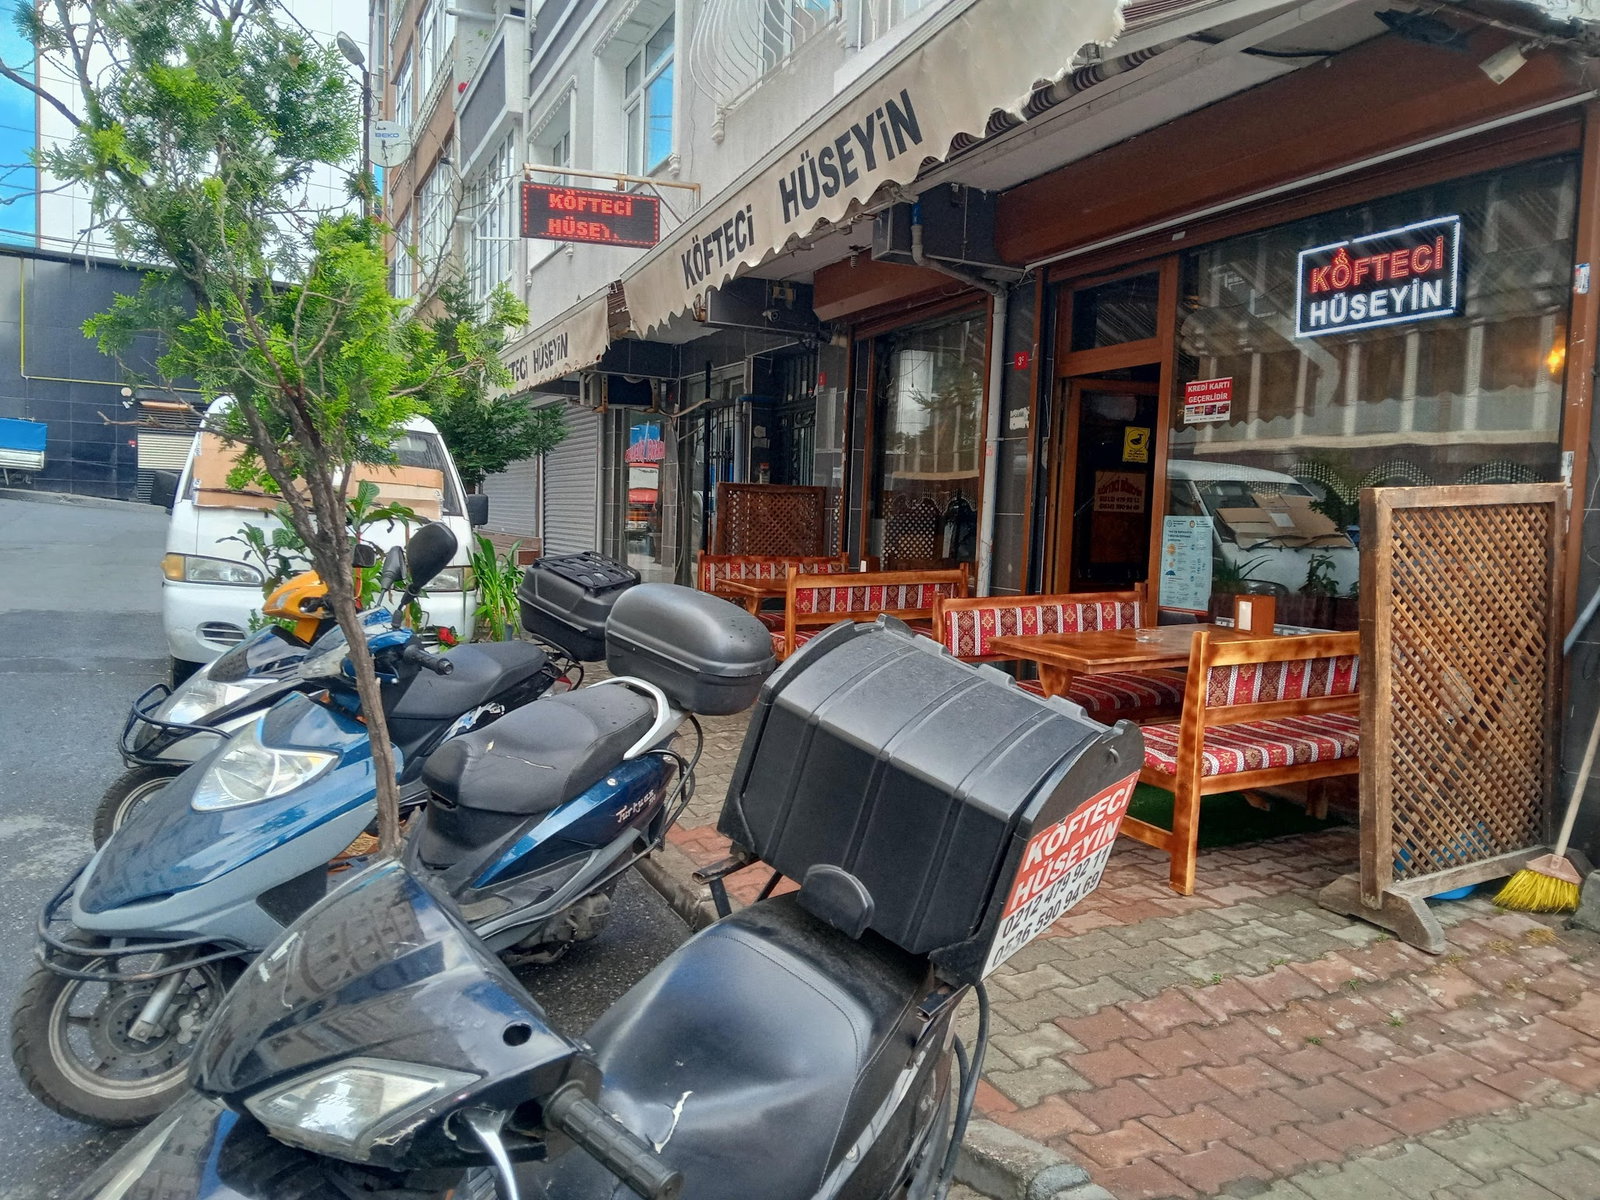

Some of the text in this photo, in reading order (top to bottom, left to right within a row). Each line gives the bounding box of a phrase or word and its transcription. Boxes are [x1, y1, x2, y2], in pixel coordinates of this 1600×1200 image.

[548, 189, 633, 216] KÖFTECİ
[681, 88, 923, 290] KÖFTECİ HÜSEYİN
[1310, 235, 1445, 293] KÖFTECİ
[1310, 278, 1444, 327] HÜSEYİN
[532, 332, 569, 374] HÜSEYİN
[1188, 381, 1230, 393] KREDİ KARTI
[1188, 392, 1228, 404] GEÇERLİDİR
[1023, 777, 1135, 872] KÖFTECİ
[1003, 845, 1109, 938] 0212 479 92 11
[1009, 817, 1121, 912] HÜSEYİN
[992, 871, 1100, 967] 0536 590 94 69
